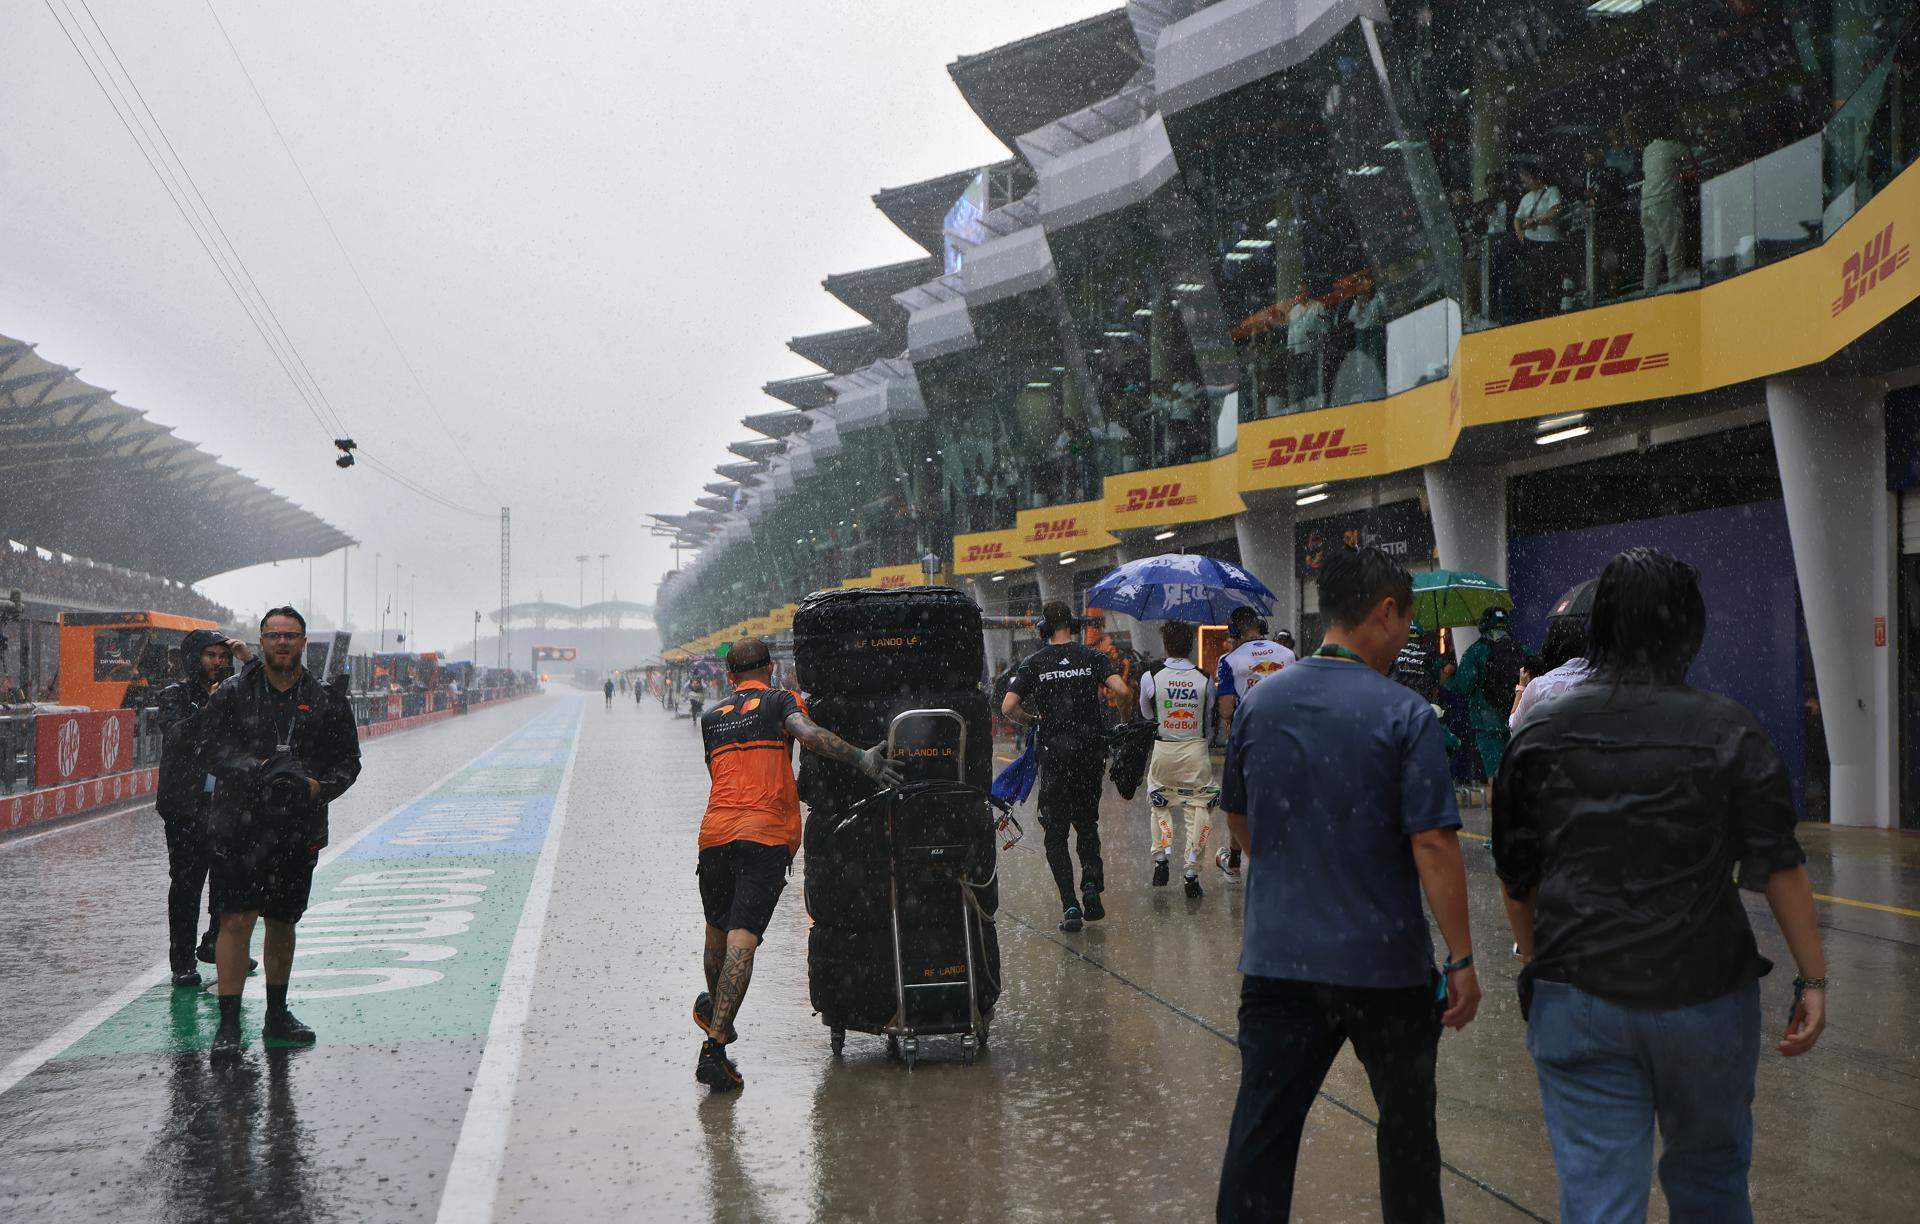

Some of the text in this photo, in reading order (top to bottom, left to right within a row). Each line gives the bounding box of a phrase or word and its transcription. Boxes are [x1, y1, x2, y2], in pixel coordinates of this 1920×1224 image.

[1840, 222, 1897, 312] DHL
[1507, 332, 1642, 392] DHL
[1267, 428, 1351, 467] DHL
[1126, 482, 1186, 512] DHL
[1032, 517, 1079, 541] DHL
[966, 542, 1003, 562] DHL
[871, 637, 902, 647] LANDO
[1251, 648, 1274, 657] HUGO
[1039, 668, 1092, 682] PETRONAS
[1168, 680, 1194, 688] HUGO
[1165, 687, 1198, 700] VISA
[908, 748, 938, 757] LANDO
[939, 964, 966, 976] LANDO
